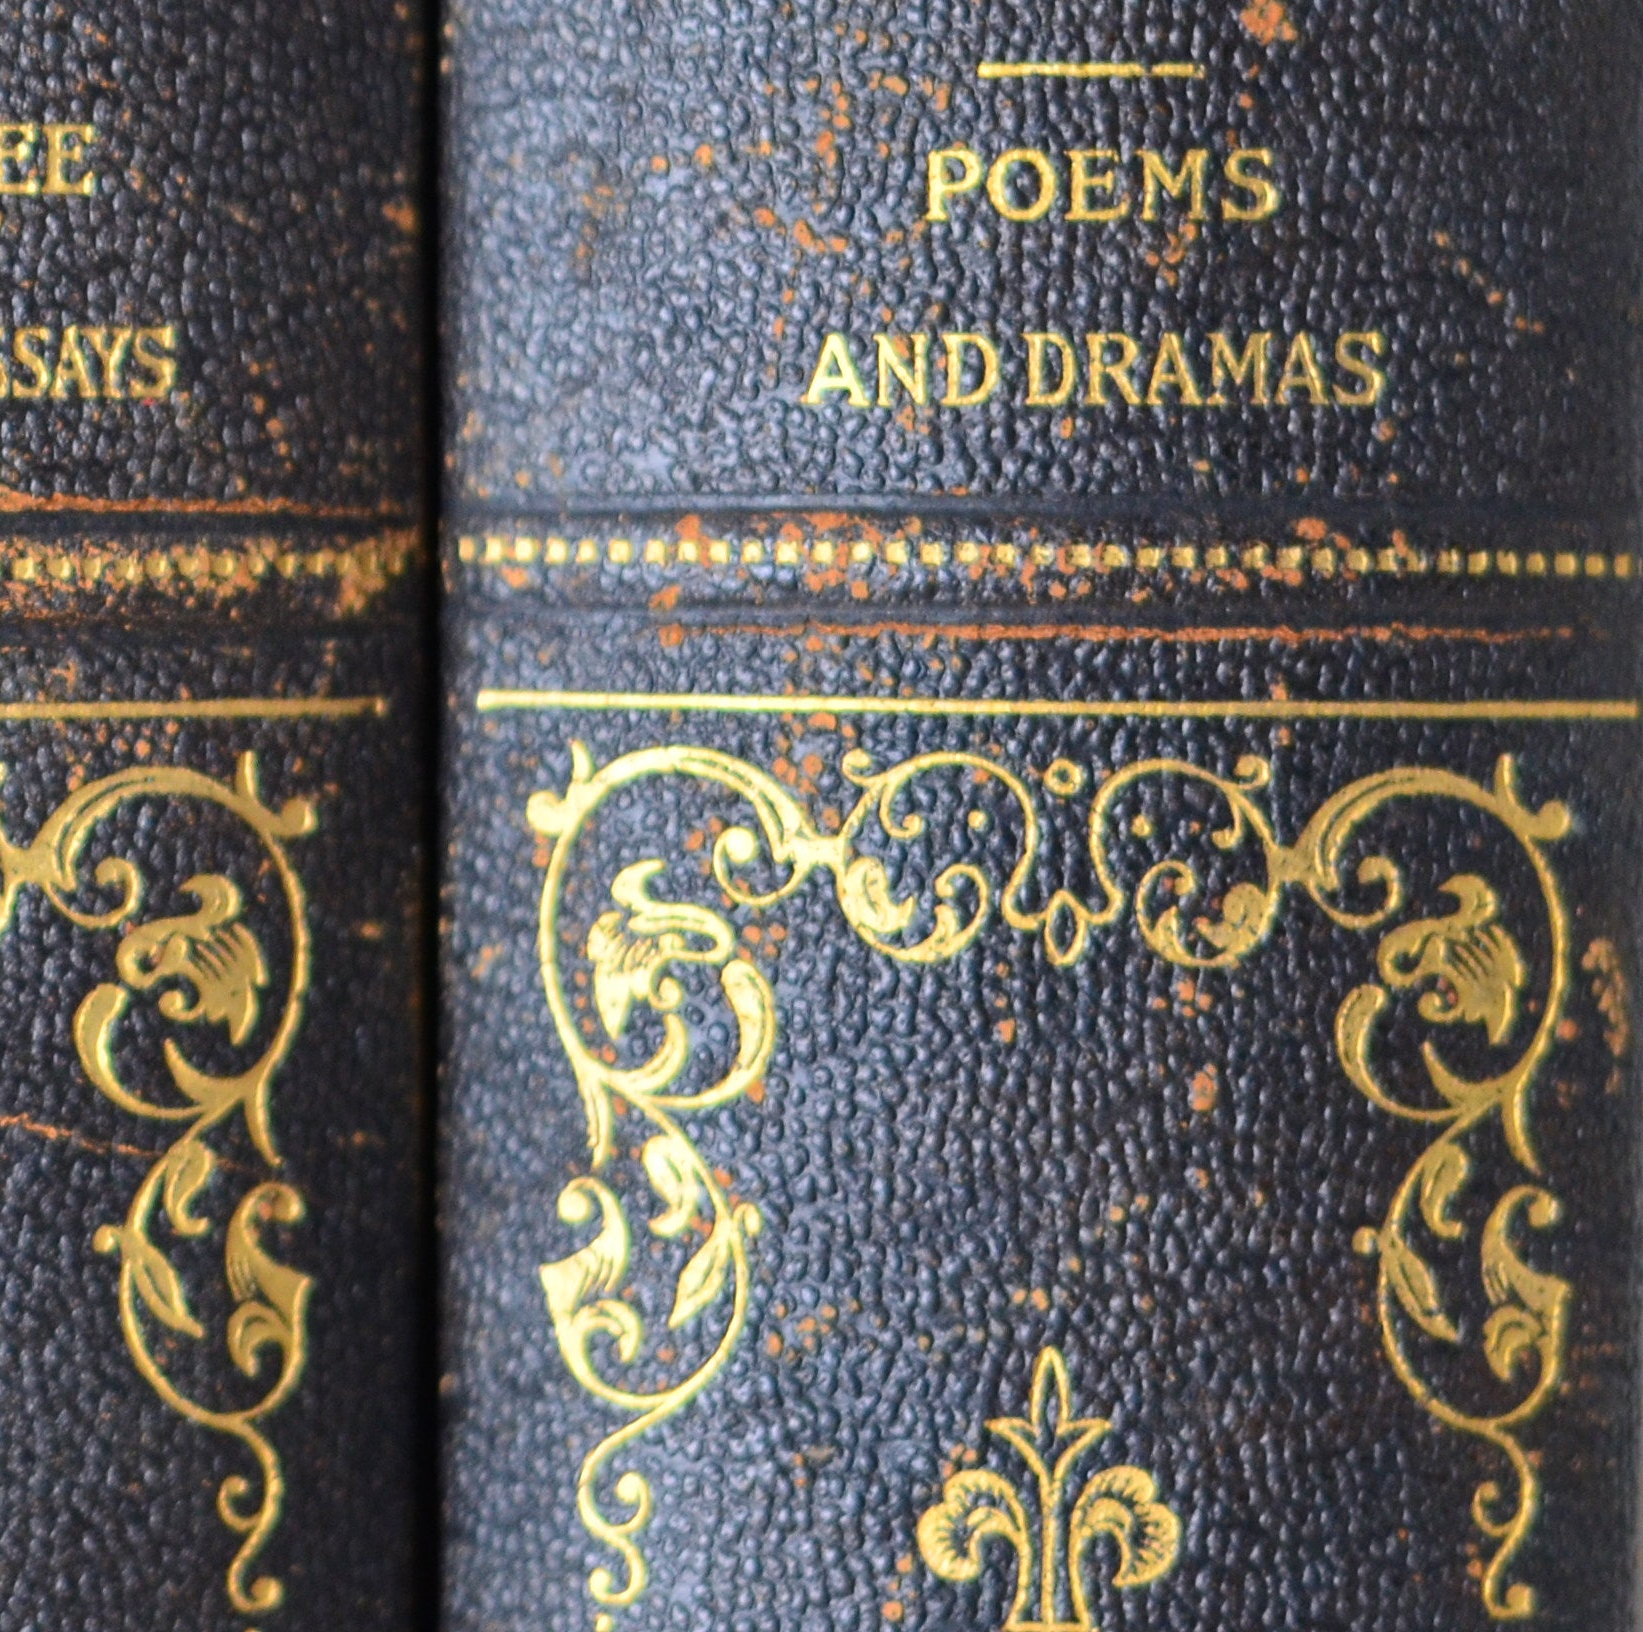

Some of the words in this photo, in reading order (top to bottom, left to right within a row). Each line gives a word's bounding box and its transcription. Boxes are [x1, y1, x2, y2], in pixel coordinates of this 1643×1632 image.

[925, 148, 1279, 222] POEMS
[803, 334, 998, 407] AND
[1024, 332, 1386, 407] DRAMAS
